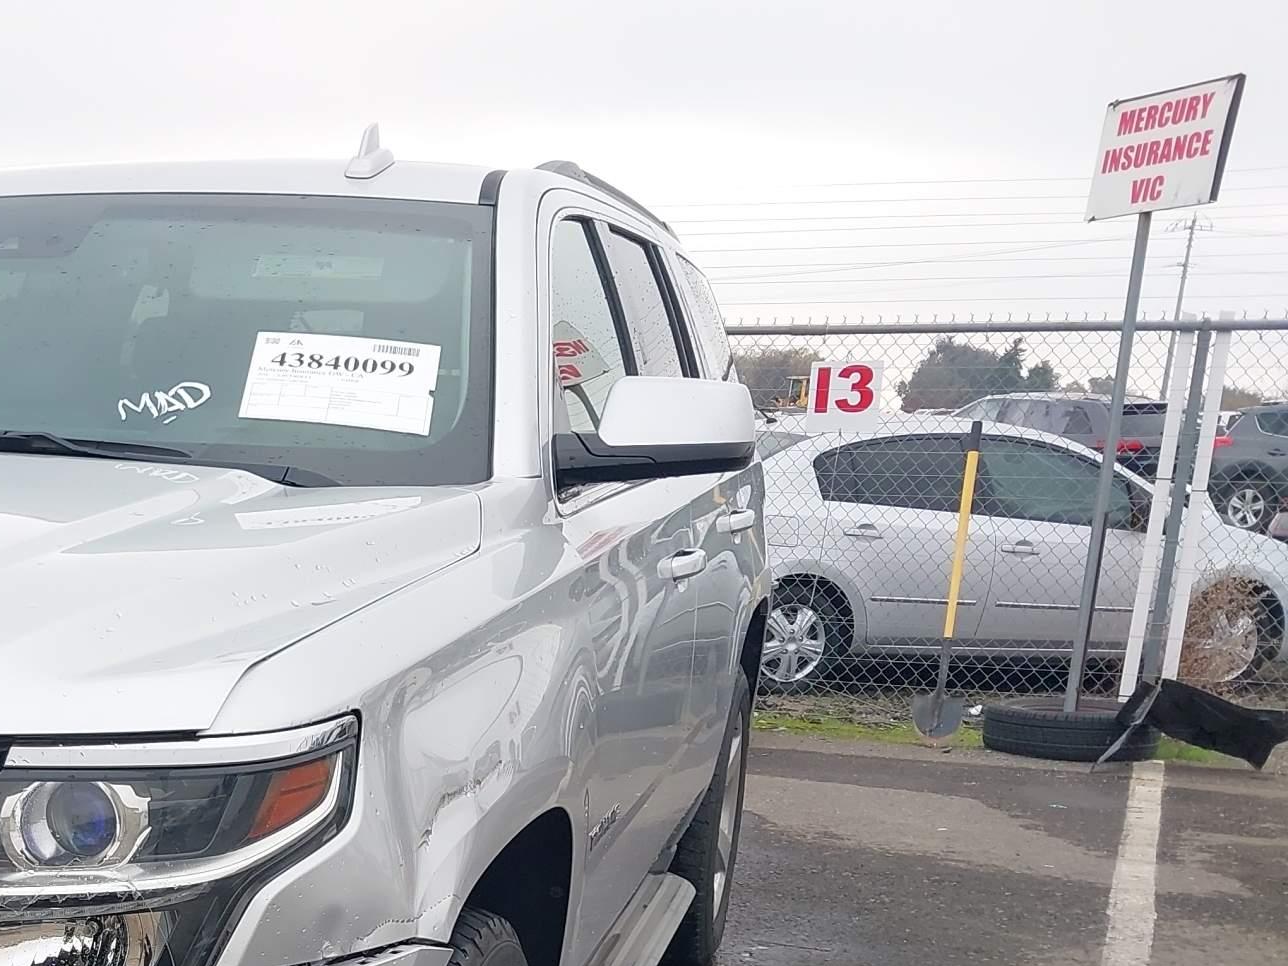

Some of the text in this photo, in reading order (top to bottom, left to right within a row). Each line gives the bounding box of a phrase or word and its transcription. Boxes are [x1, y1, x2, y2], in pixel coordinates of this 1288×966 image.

[1117, 92, 1215, 137] MERCURY
[1101, 130, 1214, 174] INSURANCE
[1130, 175, 1165, 204] VIC
[271, 351, 415, 378] 43840099
[118, 381, 211, 421] MAD
[814, 364, 874, 413] 13
